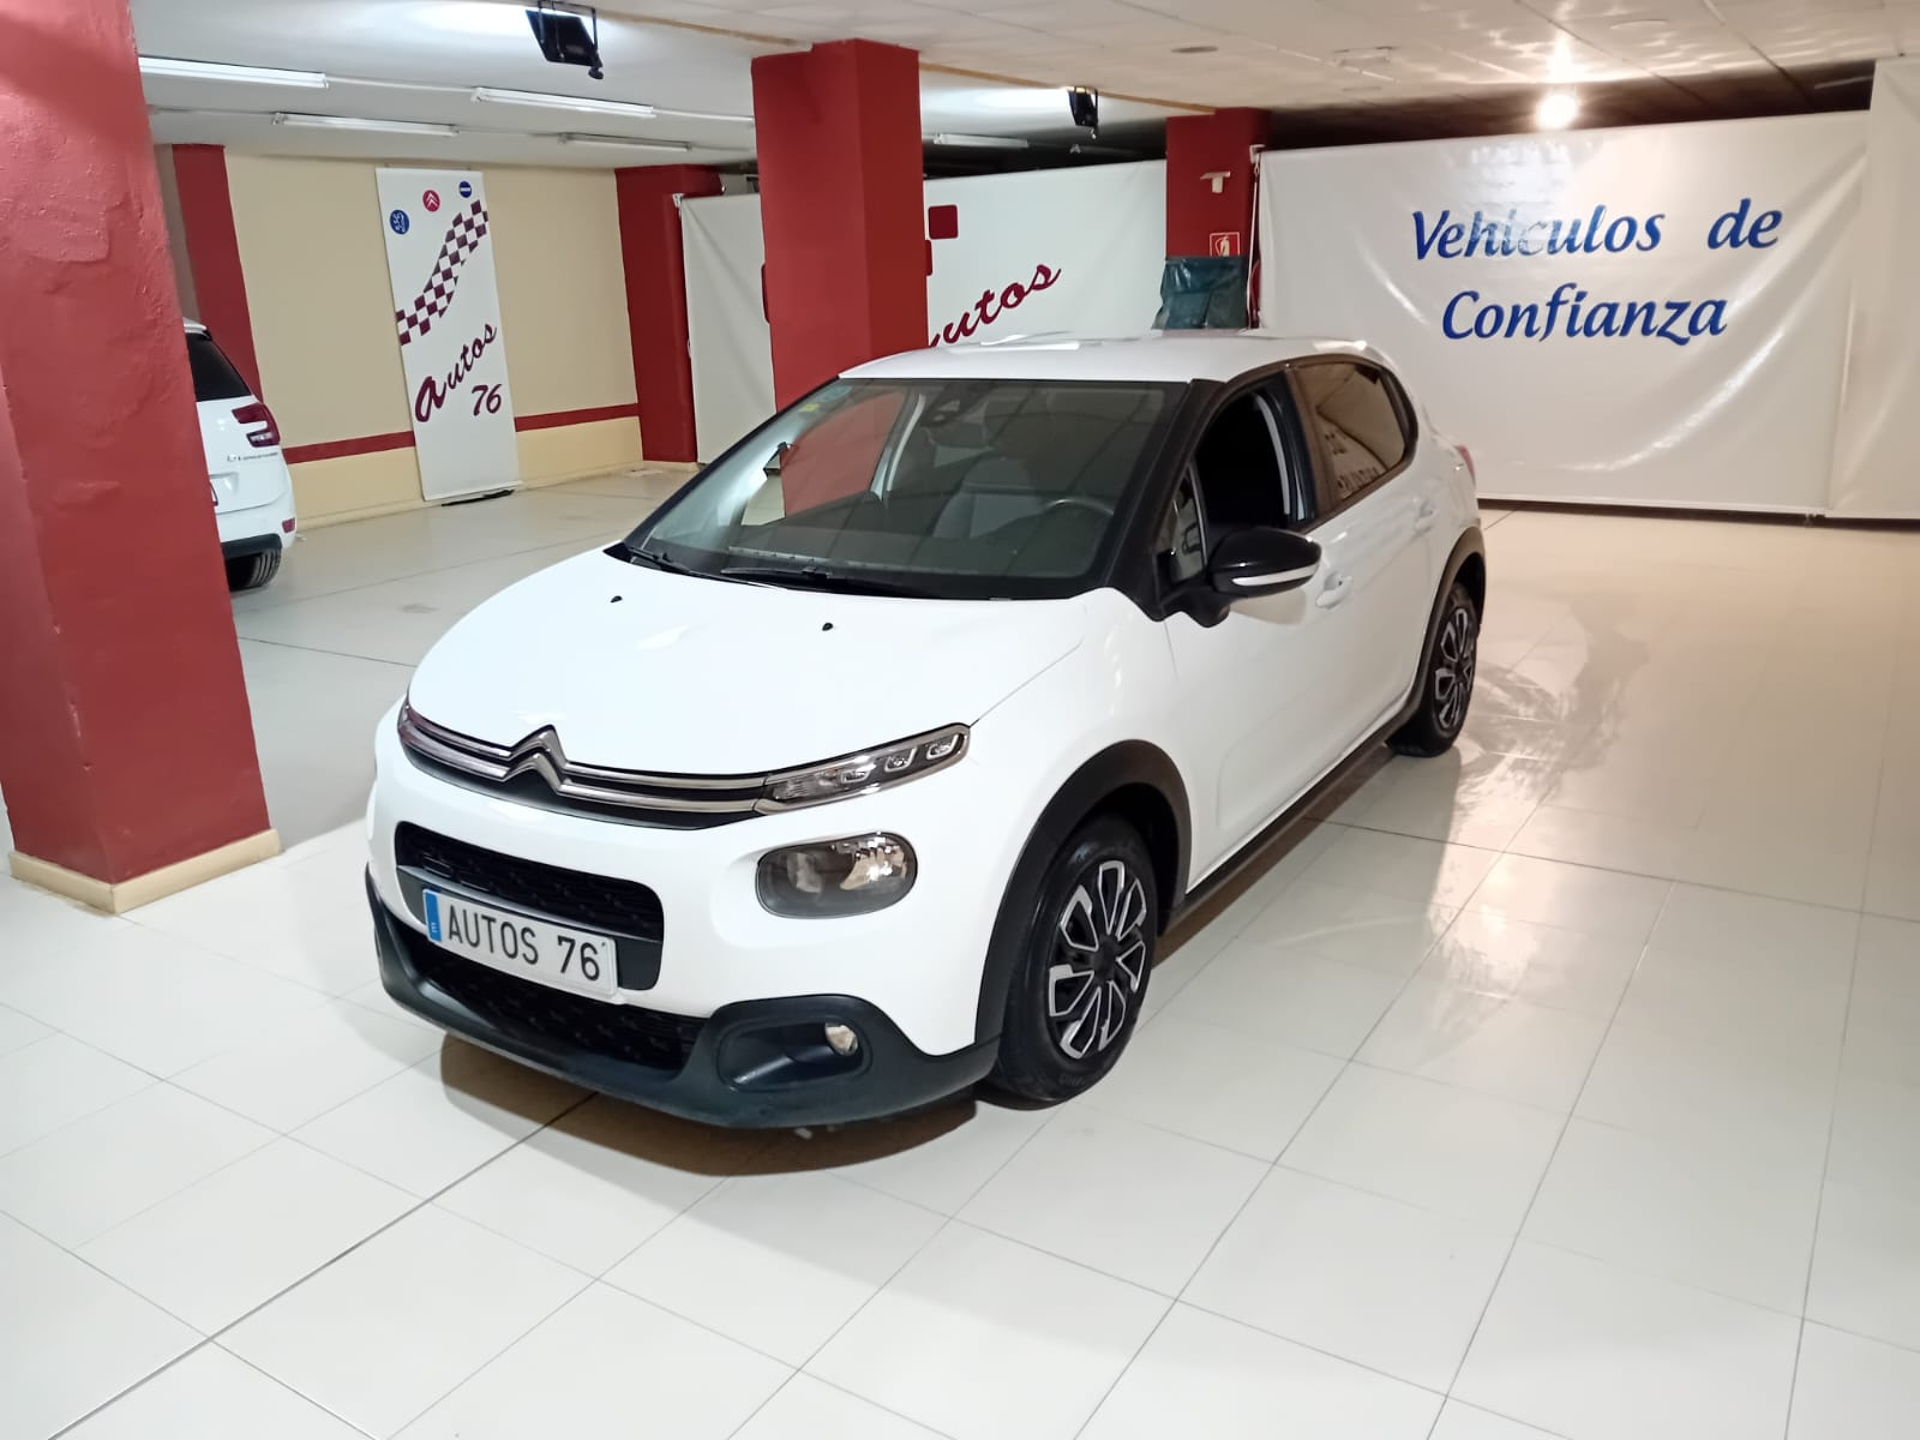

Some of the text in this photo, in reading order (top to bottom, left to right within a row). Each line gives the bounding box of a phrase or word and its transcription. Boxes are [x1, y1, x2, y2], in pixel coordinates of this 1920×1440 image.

[1707, 198, 1783, 250] de
[928, 264, 1062, 348] utos
[1442, 282, 1729, 346] Confianza
[471, 383, 503, 417] 76
[448, 905, 601, 982] AUTOS 76
